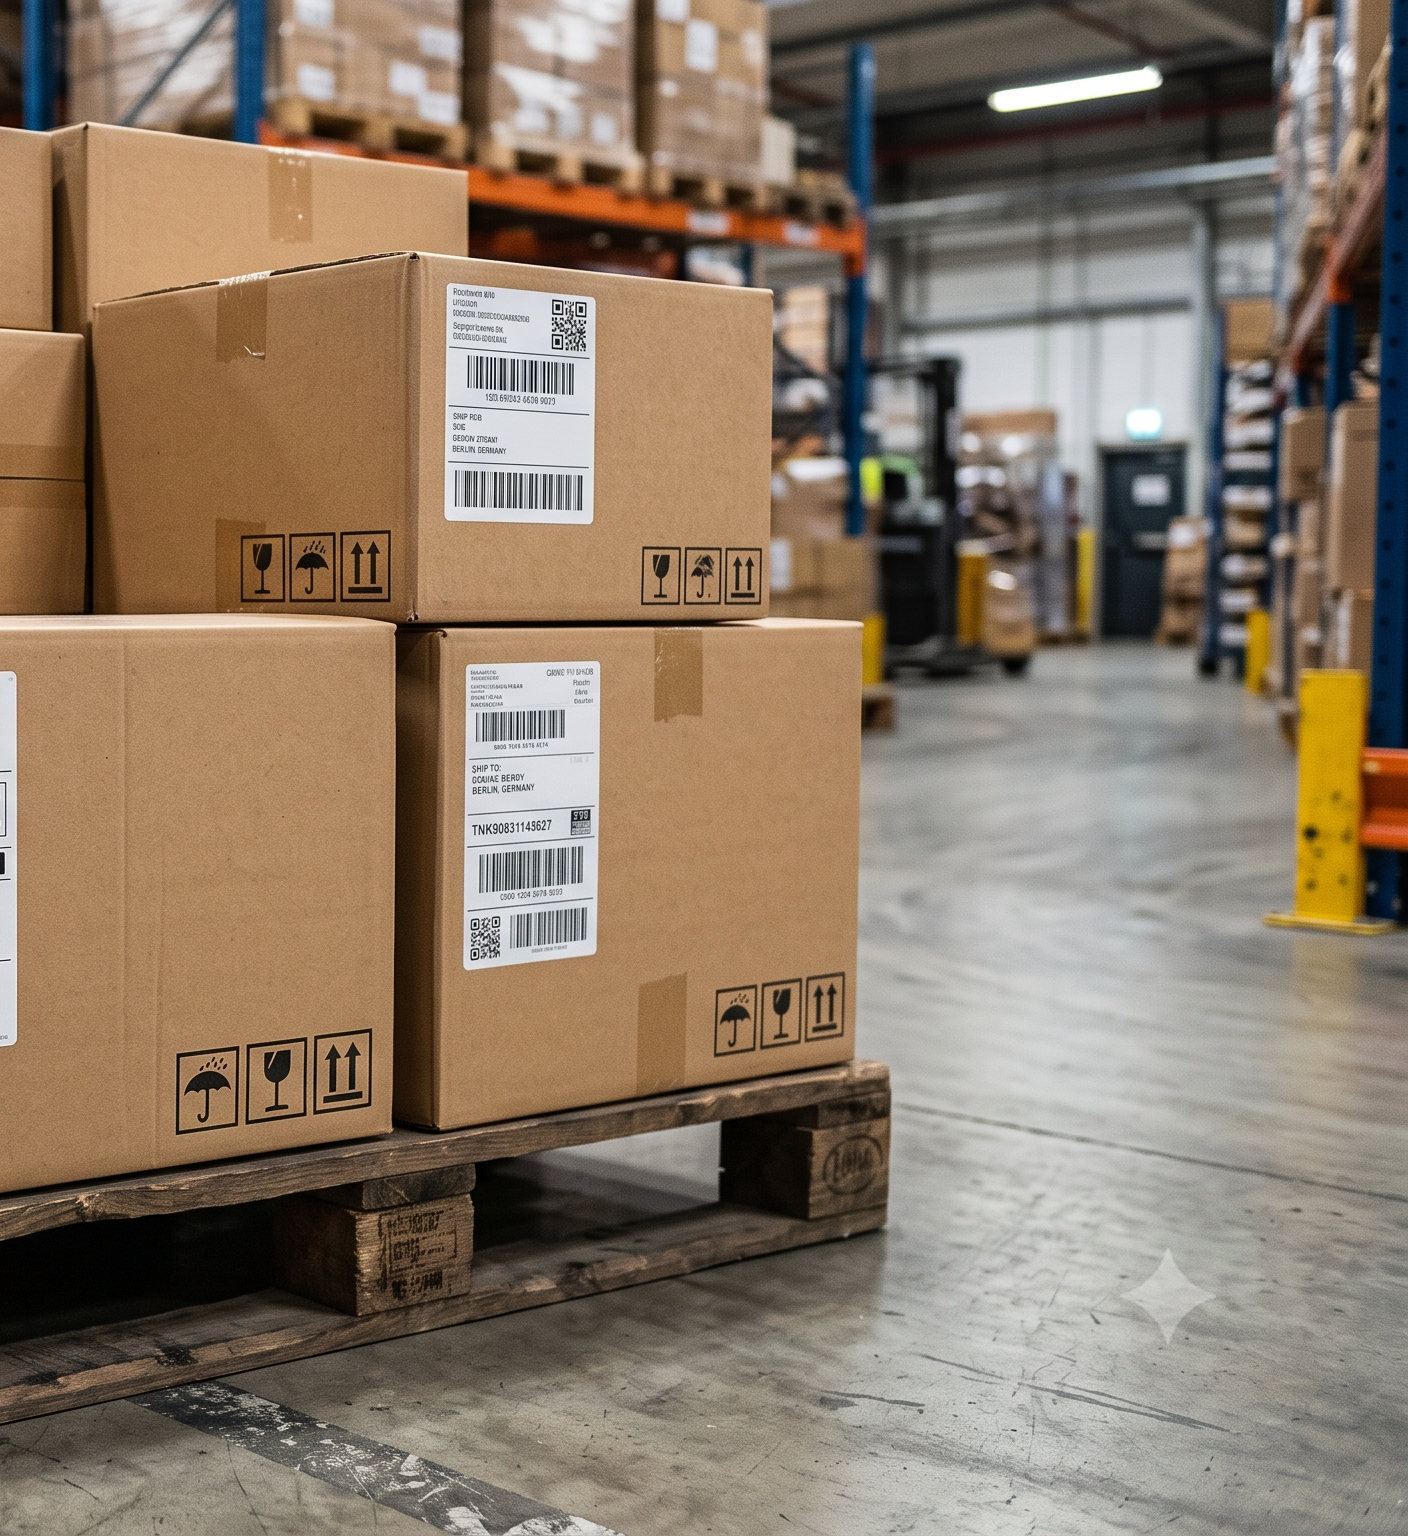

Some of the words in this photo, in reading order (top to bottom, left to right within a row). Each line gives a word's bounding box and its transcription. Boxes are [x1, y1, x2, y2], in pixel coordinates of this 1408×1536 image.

[472, 764, 489, 774] SHIP
[490, 764, 502, 772] TO:
[501, 783, 535, 793] GERMANY
